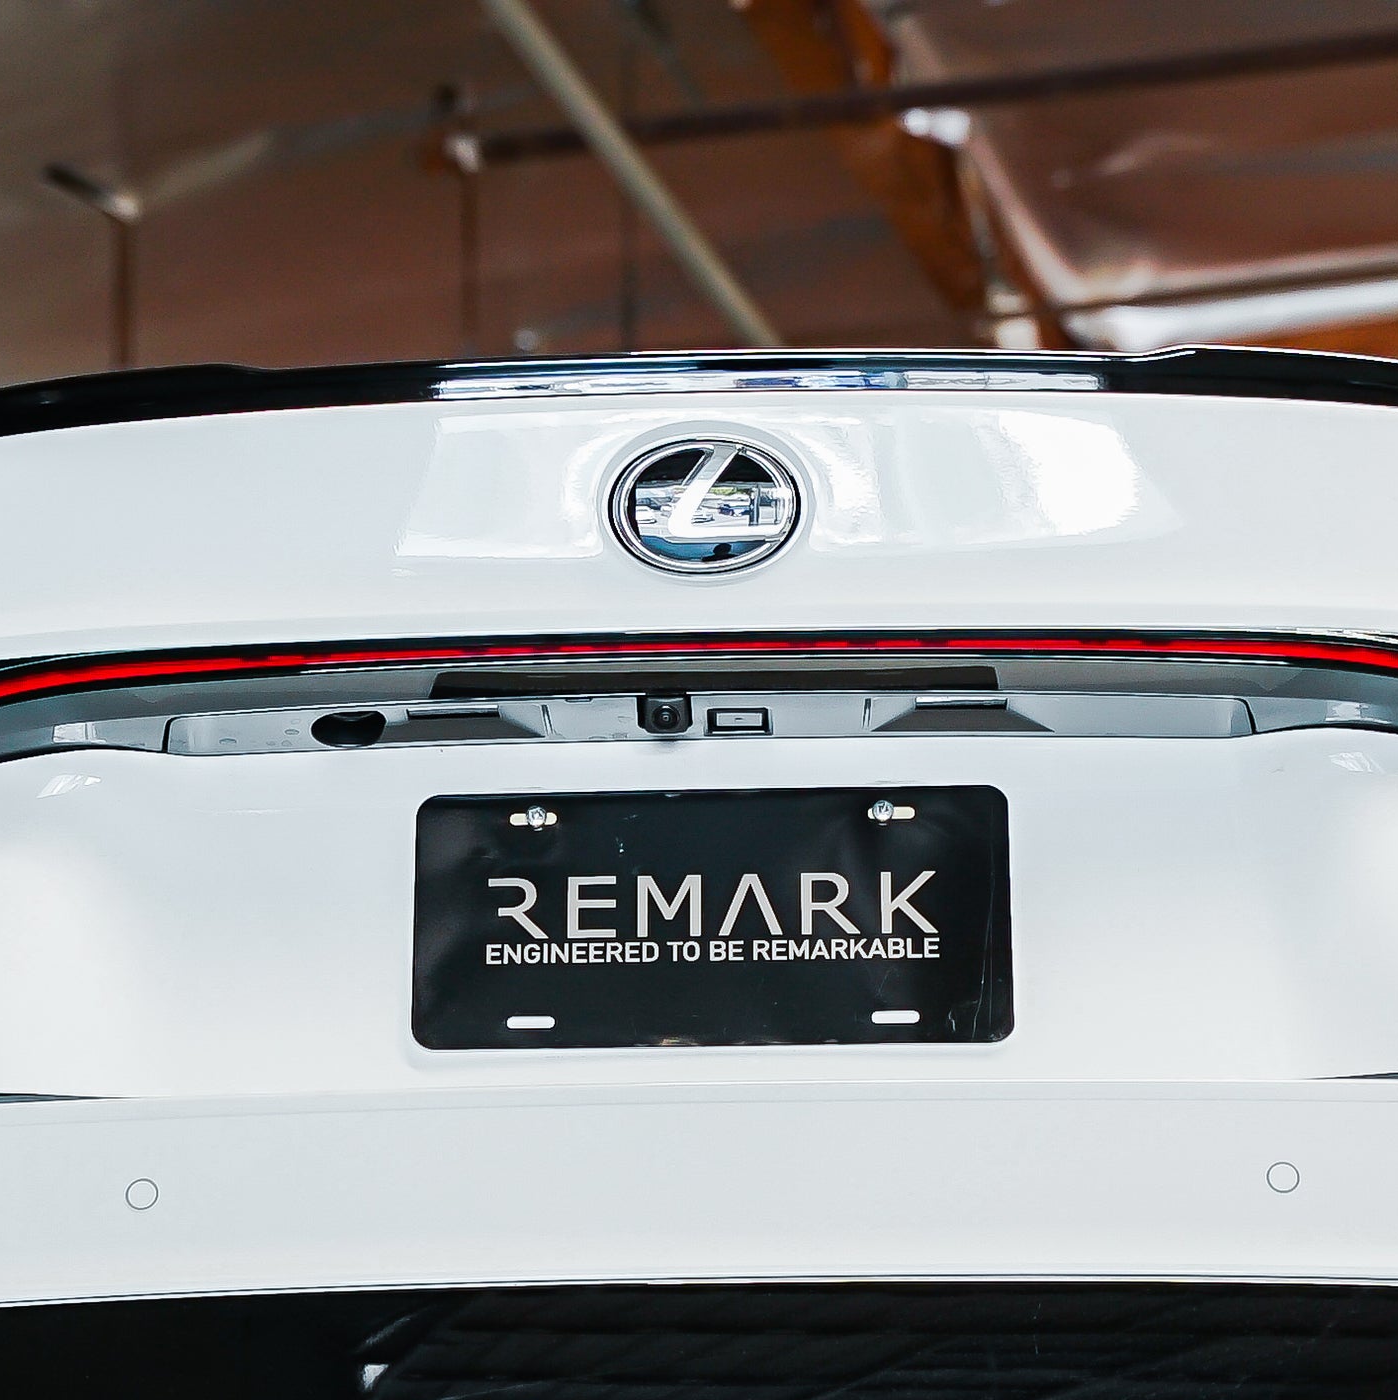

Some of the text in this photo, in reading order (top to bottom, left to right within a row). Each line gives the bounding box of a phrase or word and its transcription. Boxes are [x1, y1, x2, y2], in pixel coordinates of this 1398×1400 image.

[487, 870, 939, 940] REMARK
[485, 937, 941, 965] ENGINEERED TO BE REMARKABLE
